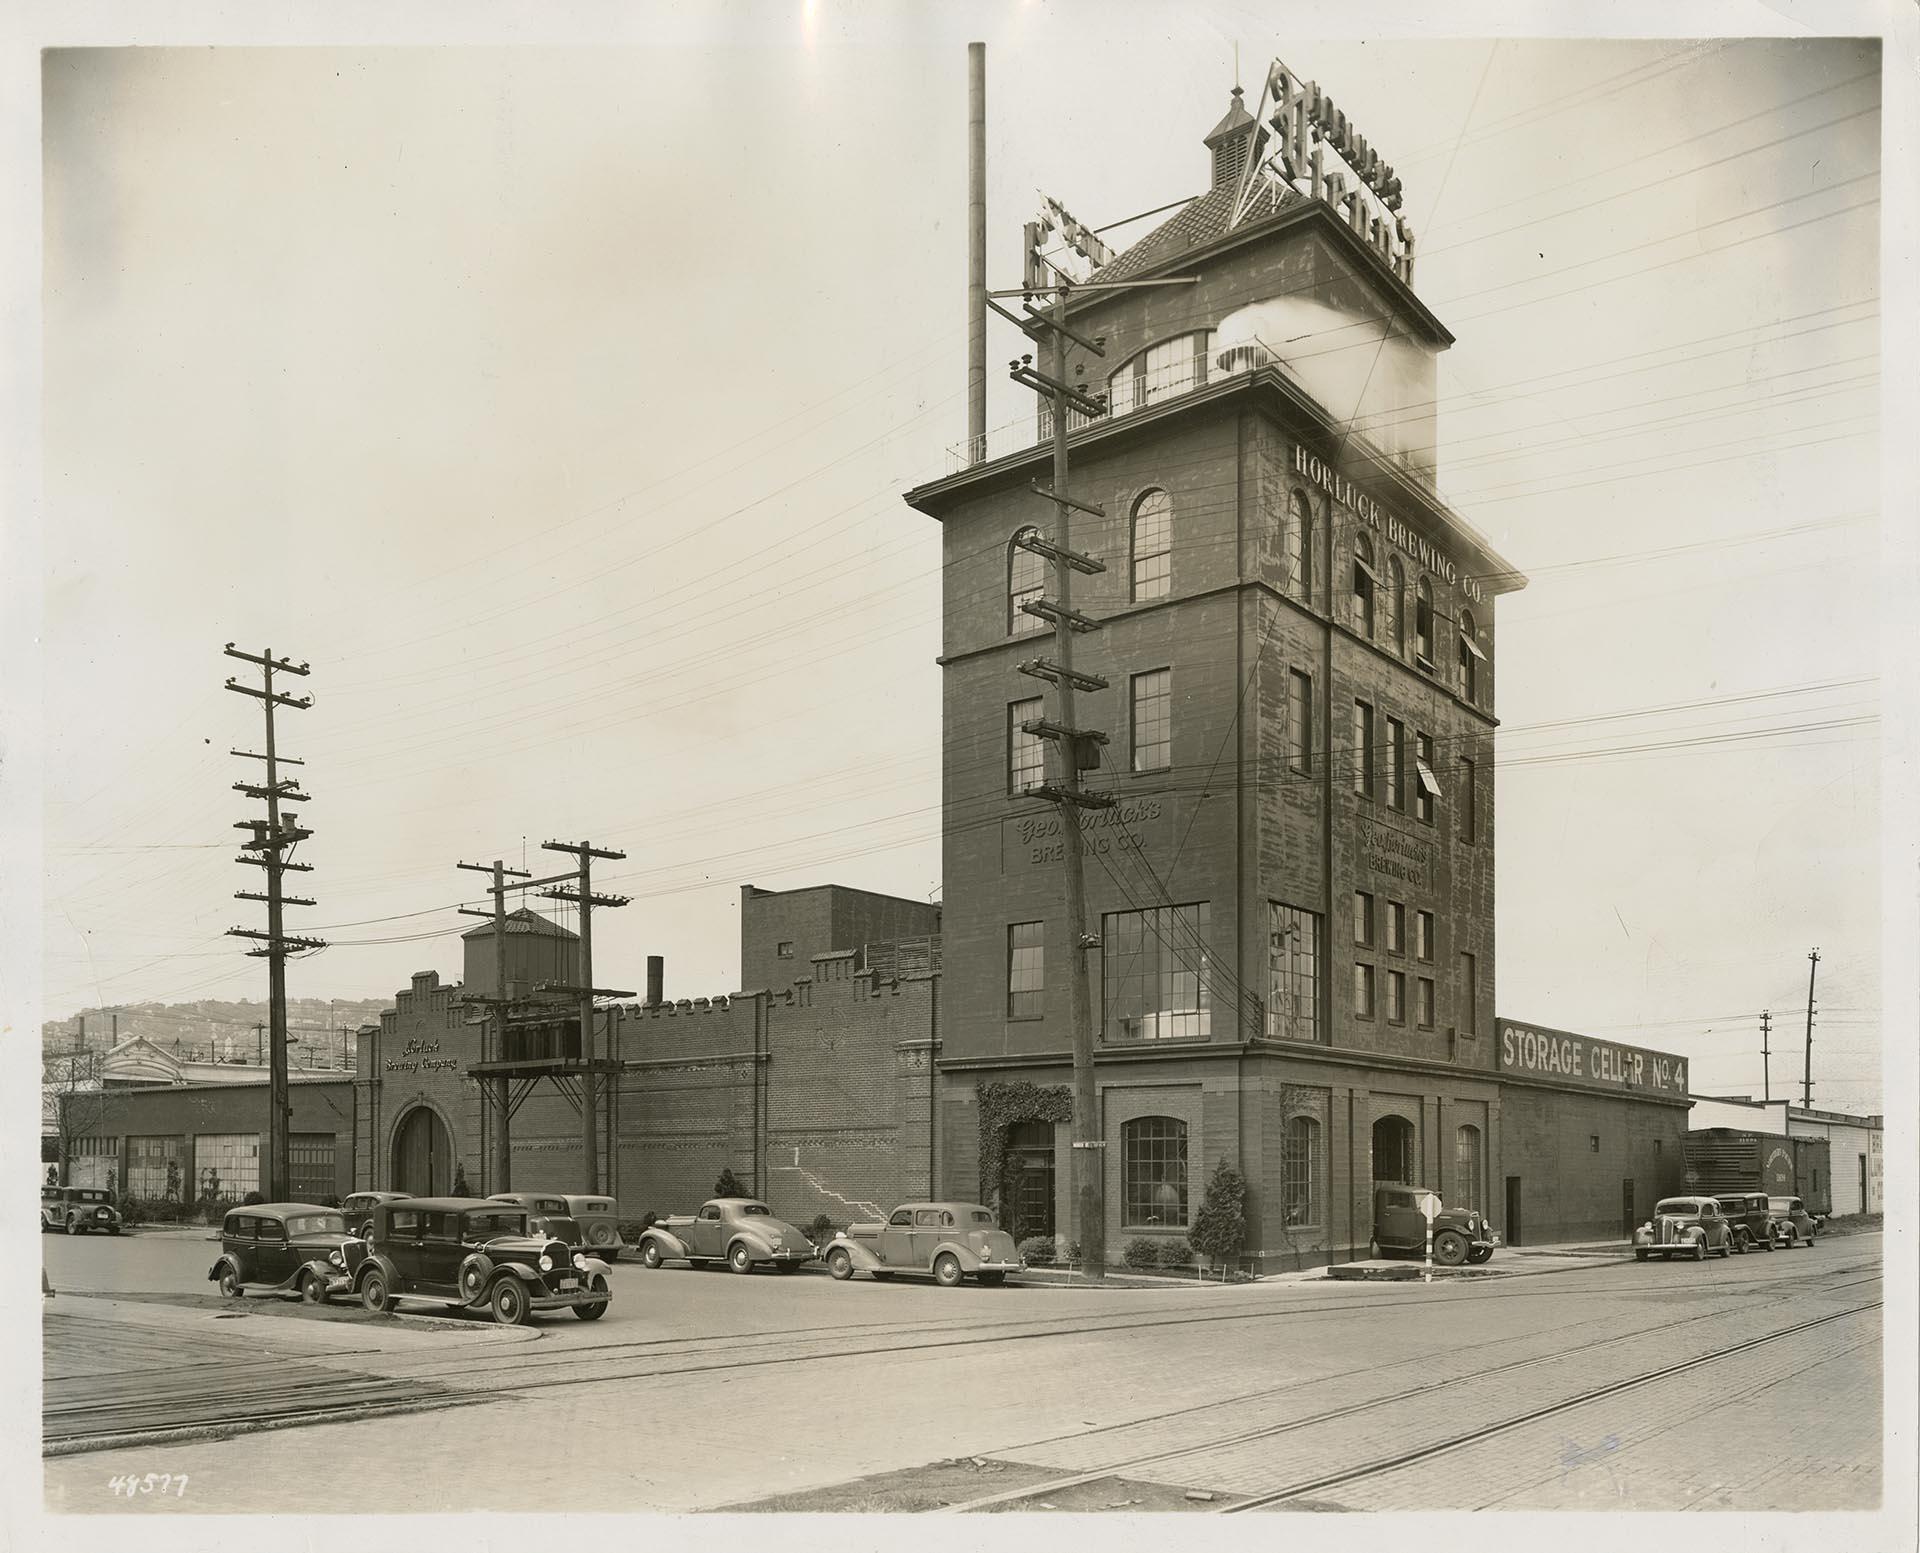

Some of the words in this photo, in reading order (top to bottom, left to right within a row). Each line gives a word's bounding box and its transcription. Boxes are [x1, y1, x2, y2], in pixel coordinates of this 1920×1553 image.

[1296, 444, 1380, 530] HORLUCK
[1387, 515, 1456, 585] BREWING
[1078, 799, 1162, 831] orluck's
[1031, 837, 1111, 864] BREING
[1503, 1027, 1583, 1077] STORAGE
[1674, 1062, 1685, 1092] 4
